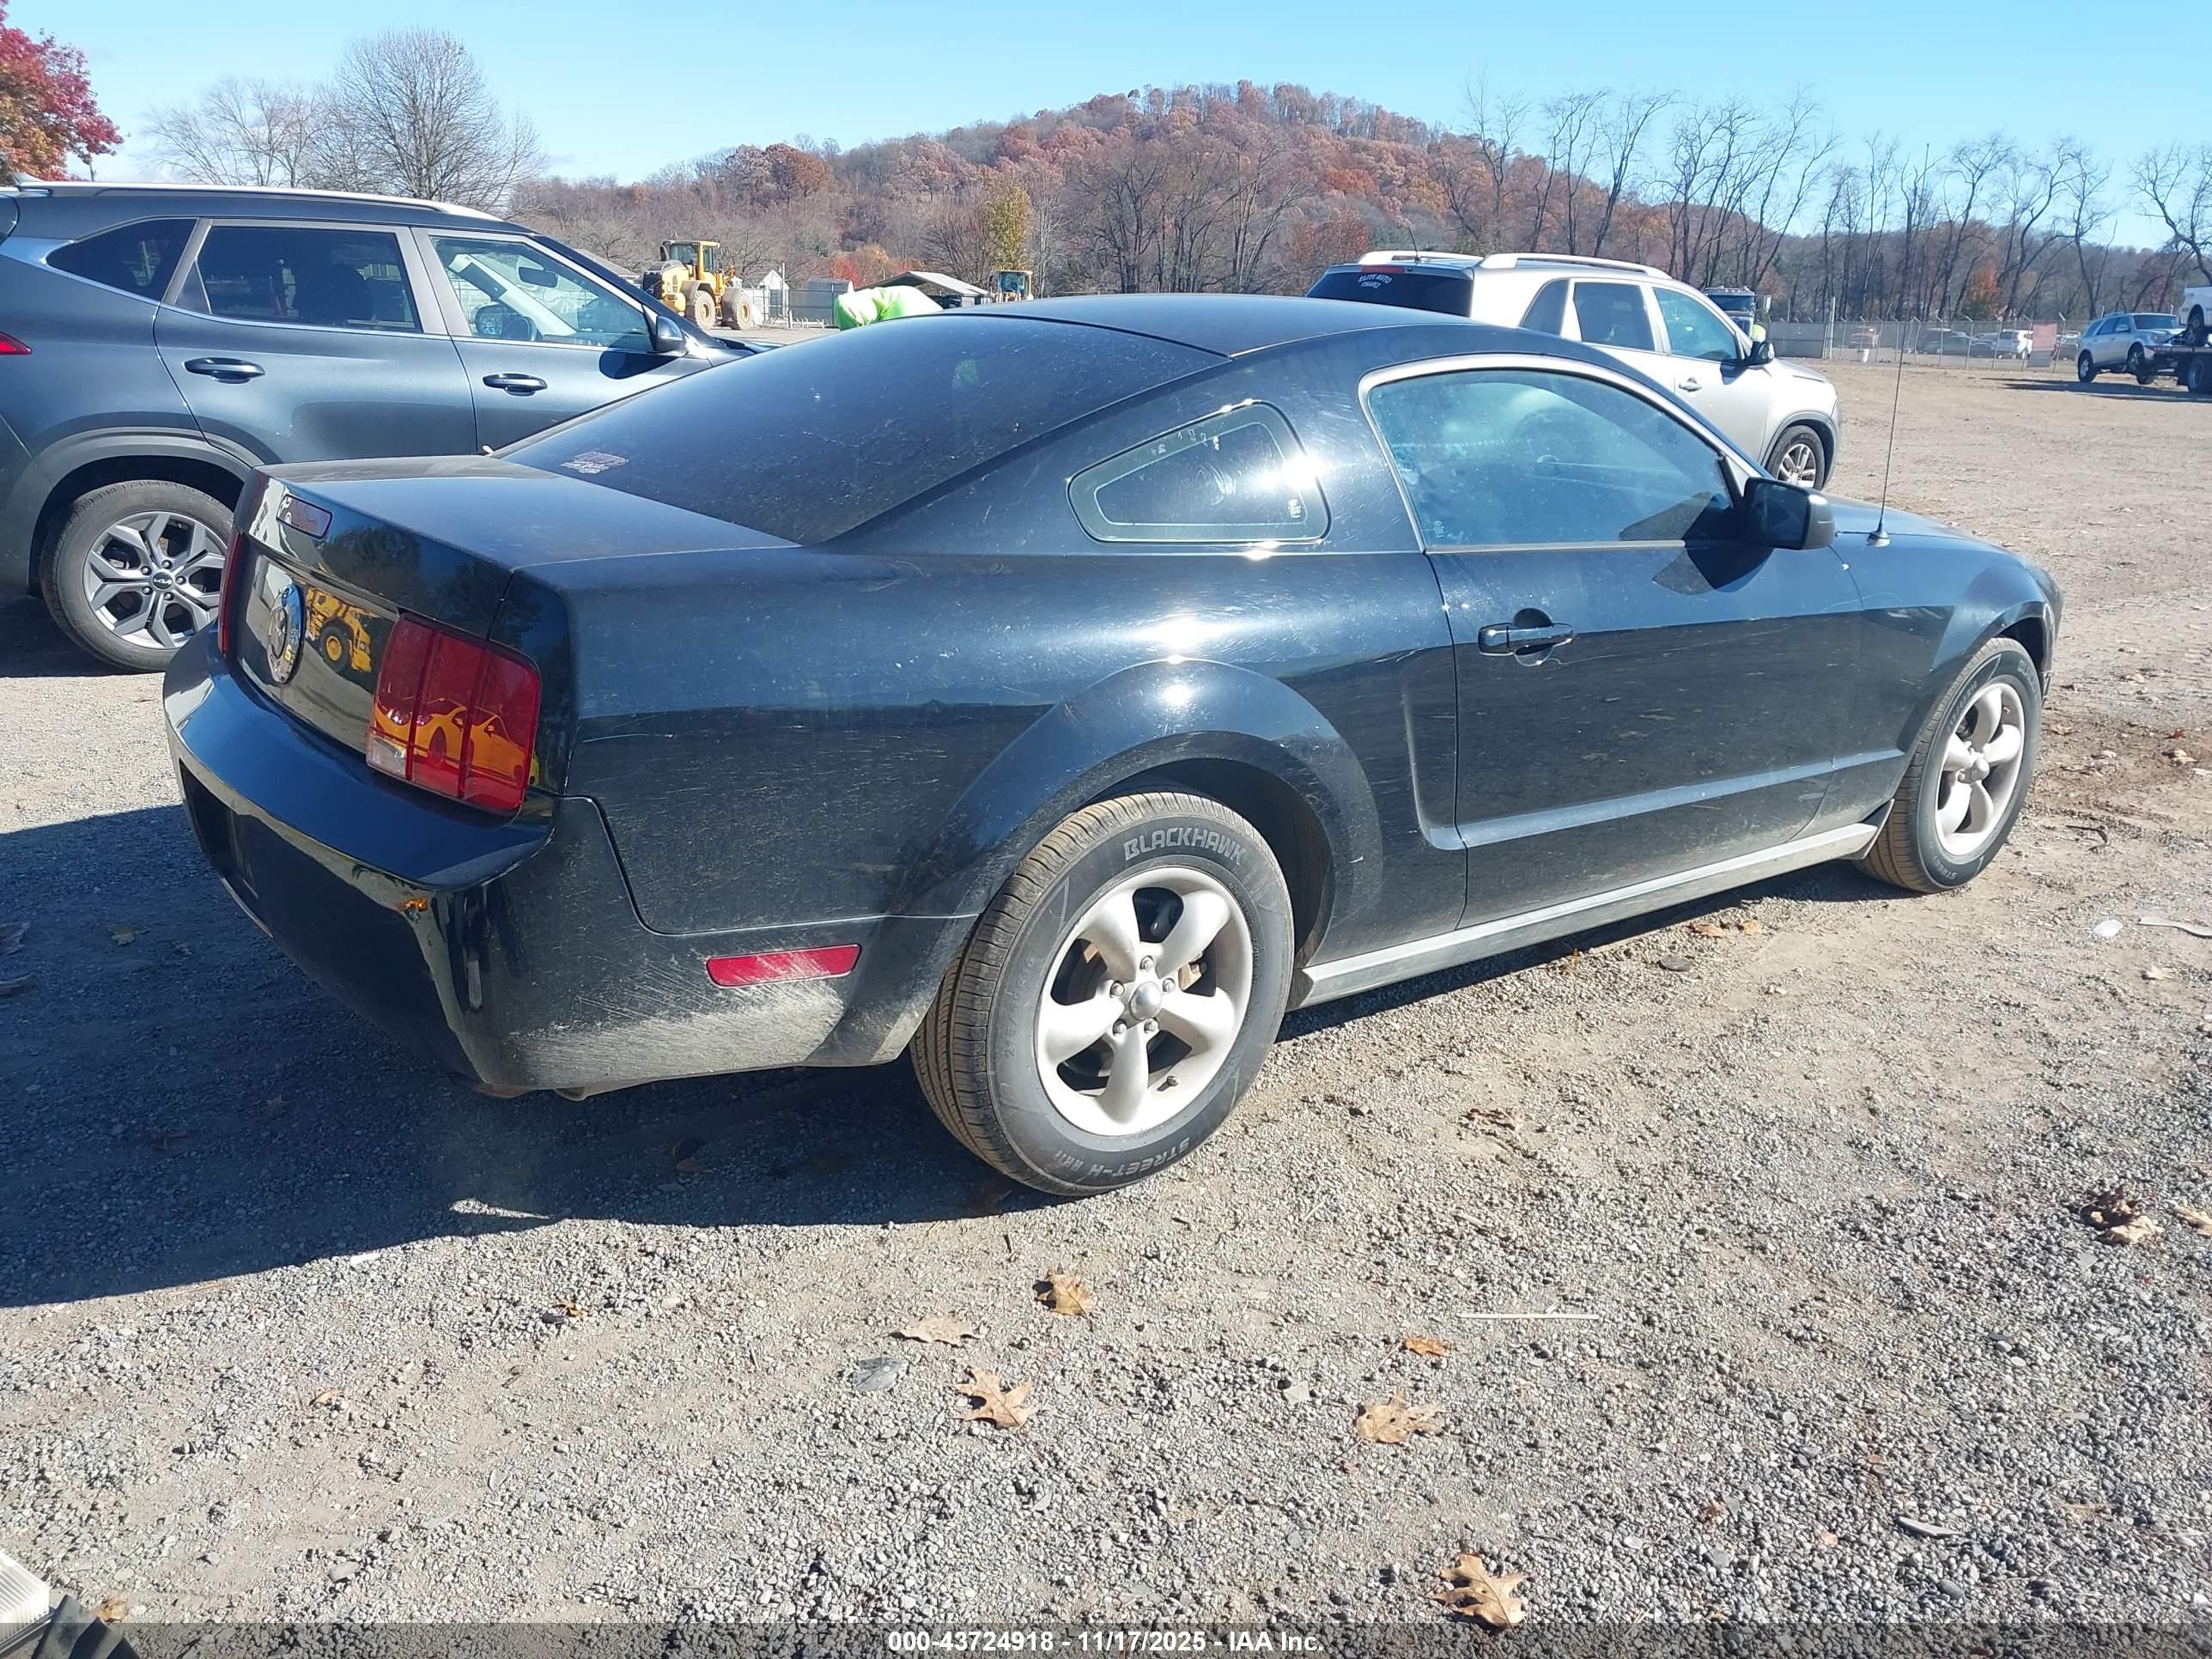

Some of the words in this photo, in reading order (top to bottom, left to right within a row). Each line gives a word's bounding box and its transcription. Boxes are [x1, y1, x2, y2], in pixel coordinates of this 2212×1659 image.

[1376, 274, 1393, 283] AUTO
[1123, 826, 1246, 866] BLACKHAWK
[1086, 1135, 1191, 1177] STREET-H
